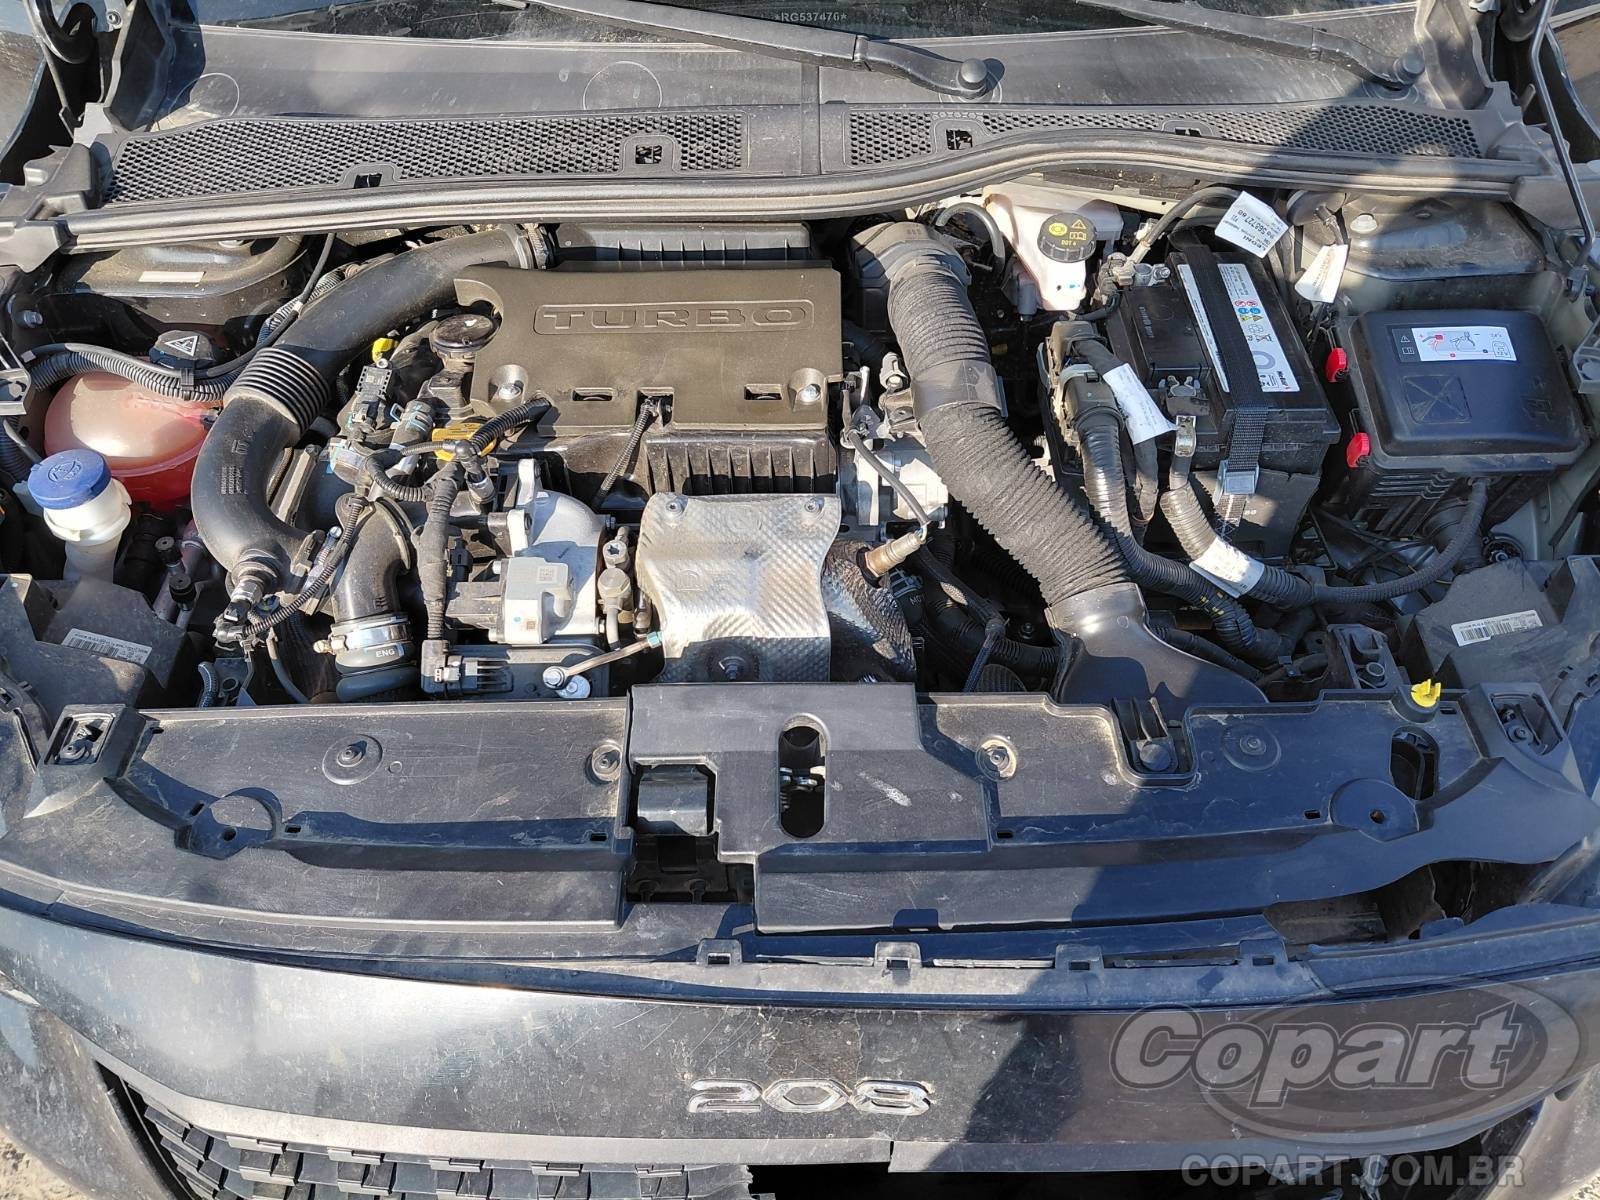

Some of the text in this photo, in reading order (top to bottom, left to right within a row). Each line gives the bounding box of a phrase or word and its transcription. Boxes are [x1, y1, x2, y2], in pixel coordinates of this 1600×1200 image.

[543, 306, 807, 330] TURBO
[375, 648, 395, 658] ENG
[687, 1078, 931, 1116] 208
